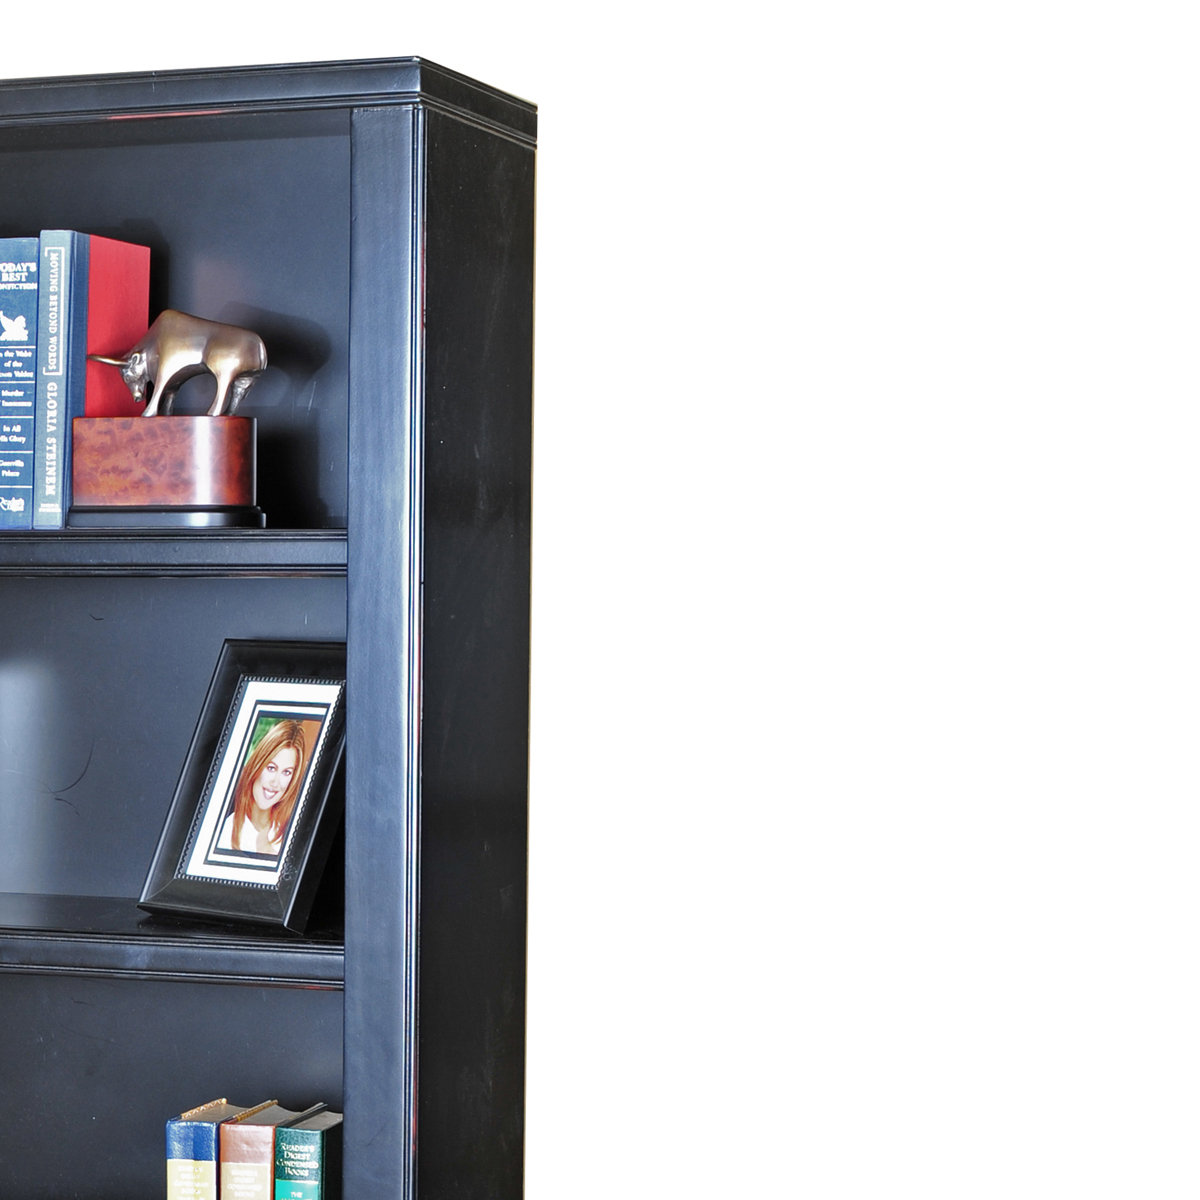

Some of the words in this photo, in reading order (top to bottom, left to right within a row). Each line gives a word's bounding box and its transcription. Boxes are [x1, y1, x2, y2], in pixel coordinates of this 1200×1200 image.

[1, 272, 28, 282] BEST
[49, 252, 59, 292] MOVING
[48, 294, 58, 334] BEYOND
[48, 335, 58, 371] WORDS
[46, 381, 58, 433] GLORIA
[45, 437, 57, 497] STEINEM
